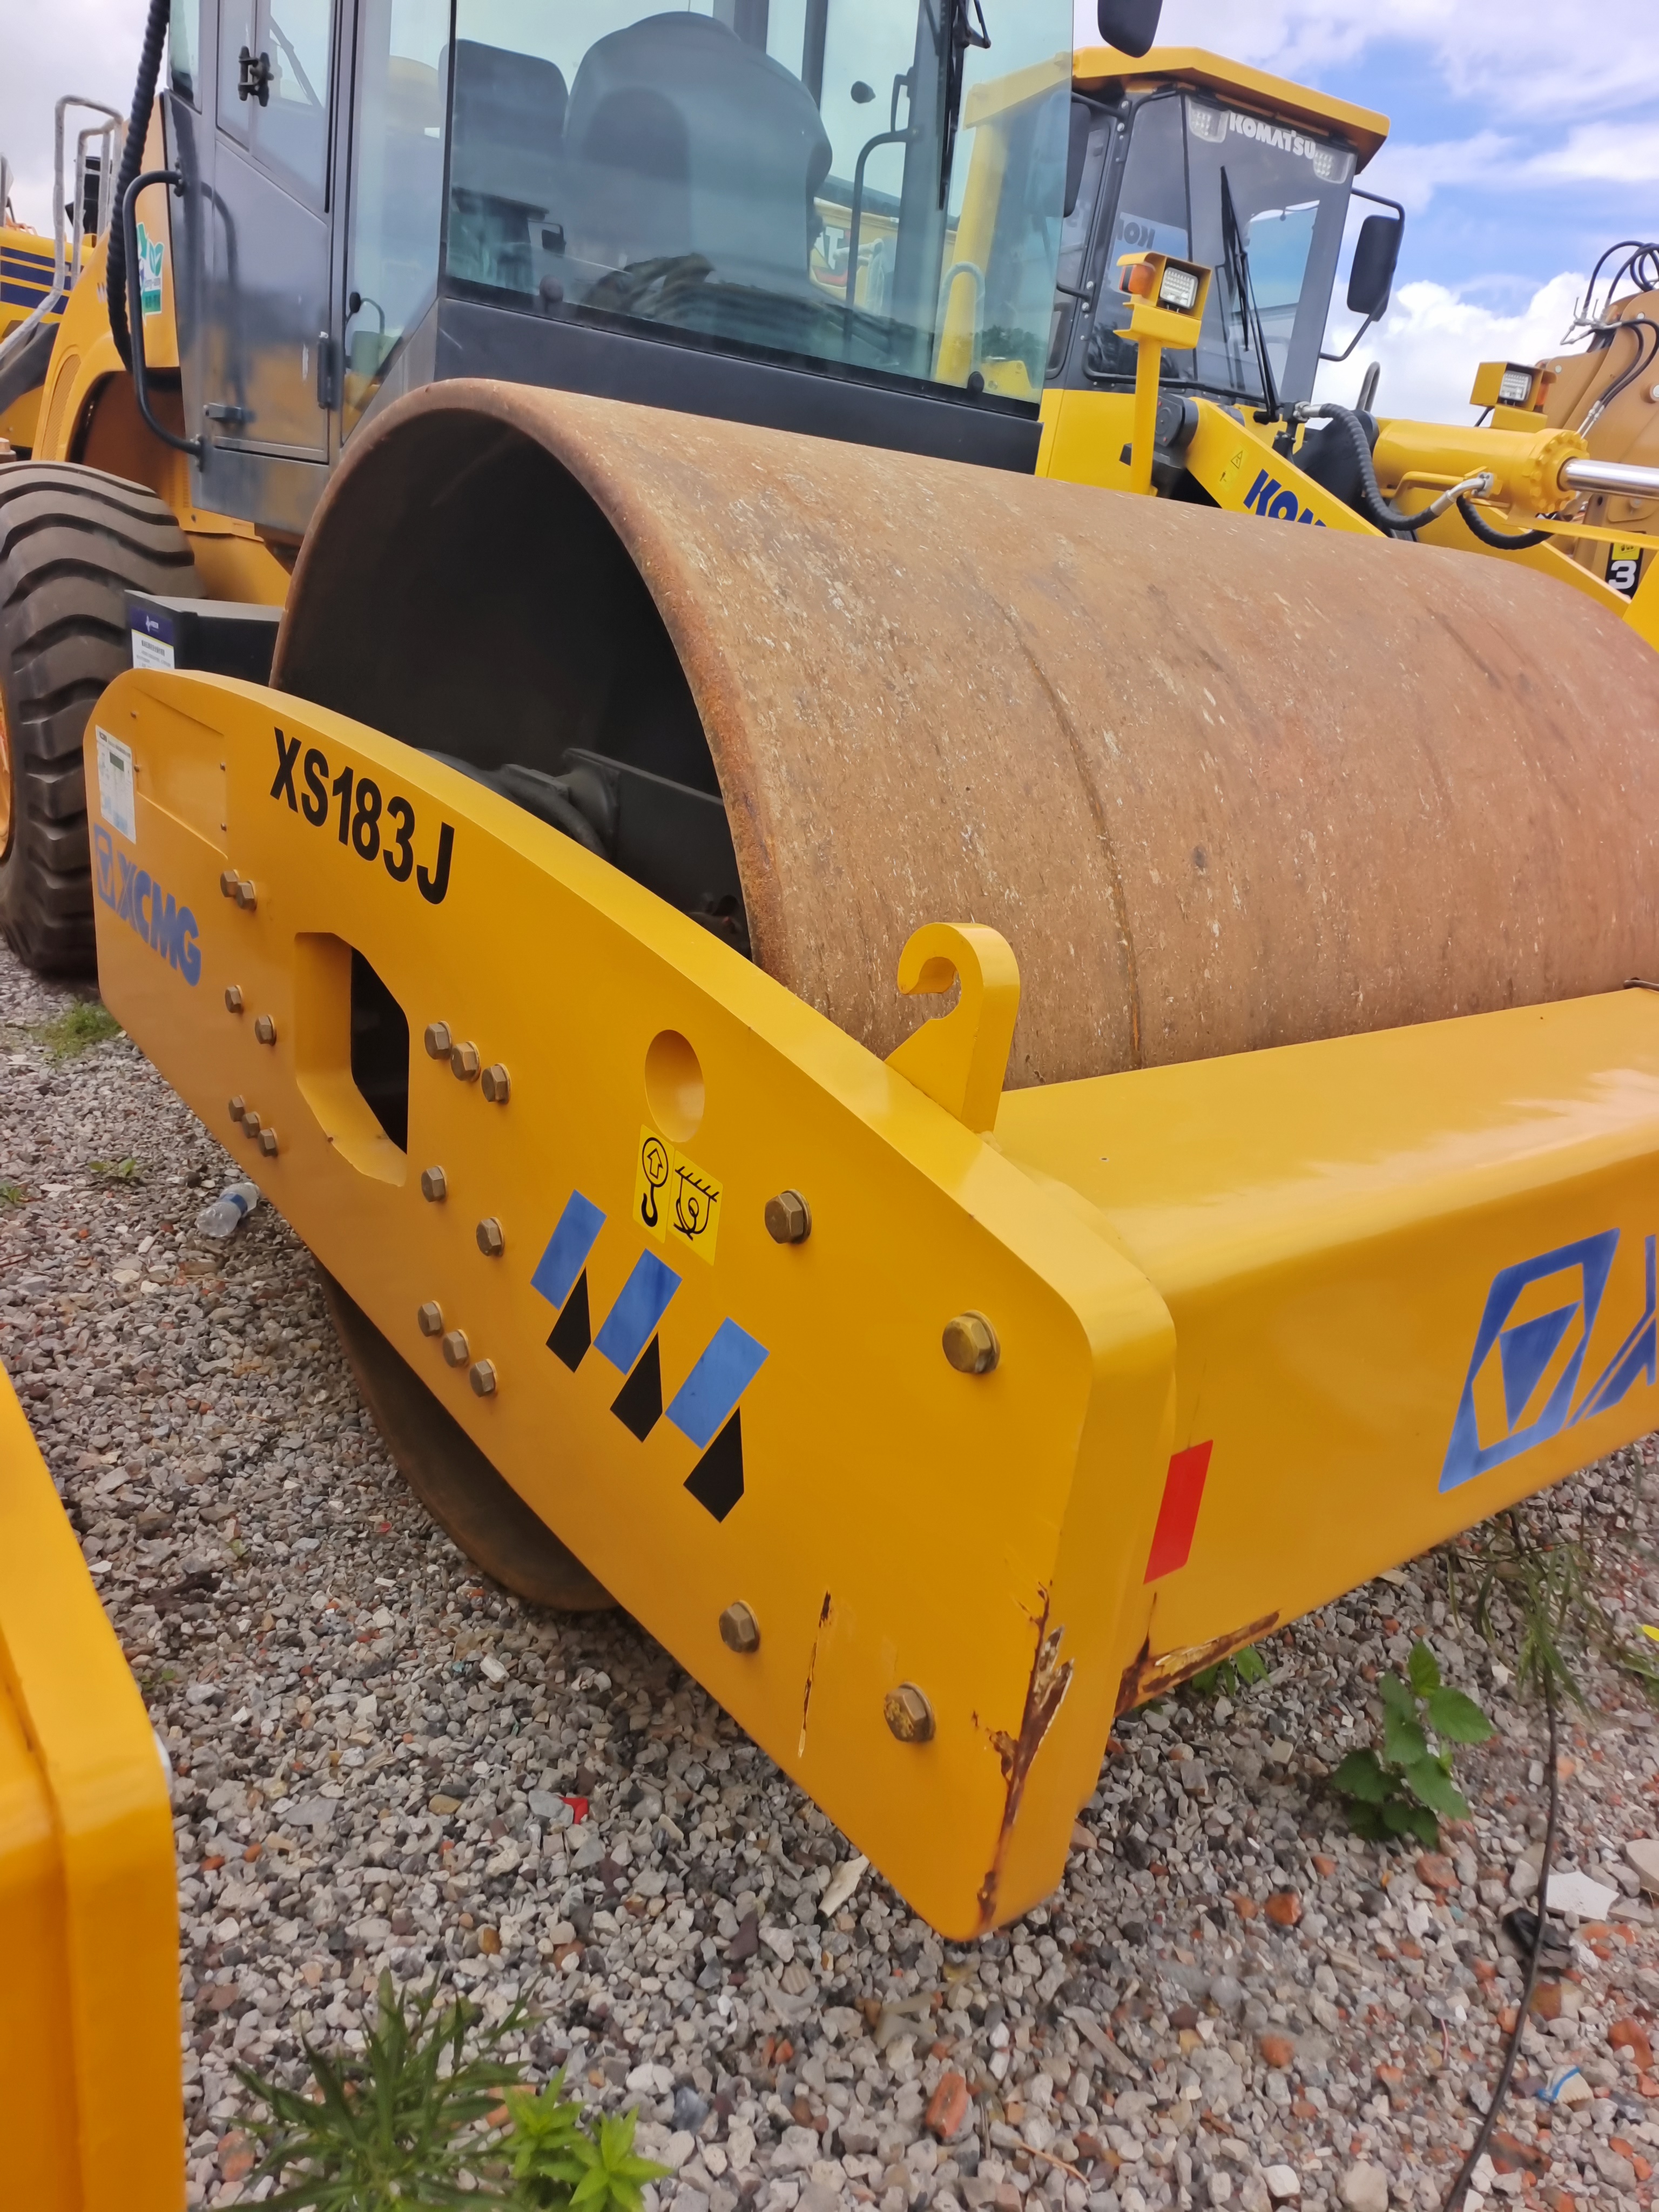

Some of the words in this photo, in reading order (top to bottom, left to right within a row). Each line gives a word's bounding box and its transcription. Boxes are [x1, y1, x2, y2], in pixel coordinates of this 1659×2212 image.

[1229, 112, 1316, 159] KOMATSU
[1243, 468, 1327, 528] KO
[270, 726, 455, 905] XS183J
[116, 849, 201, 987] XCMG
